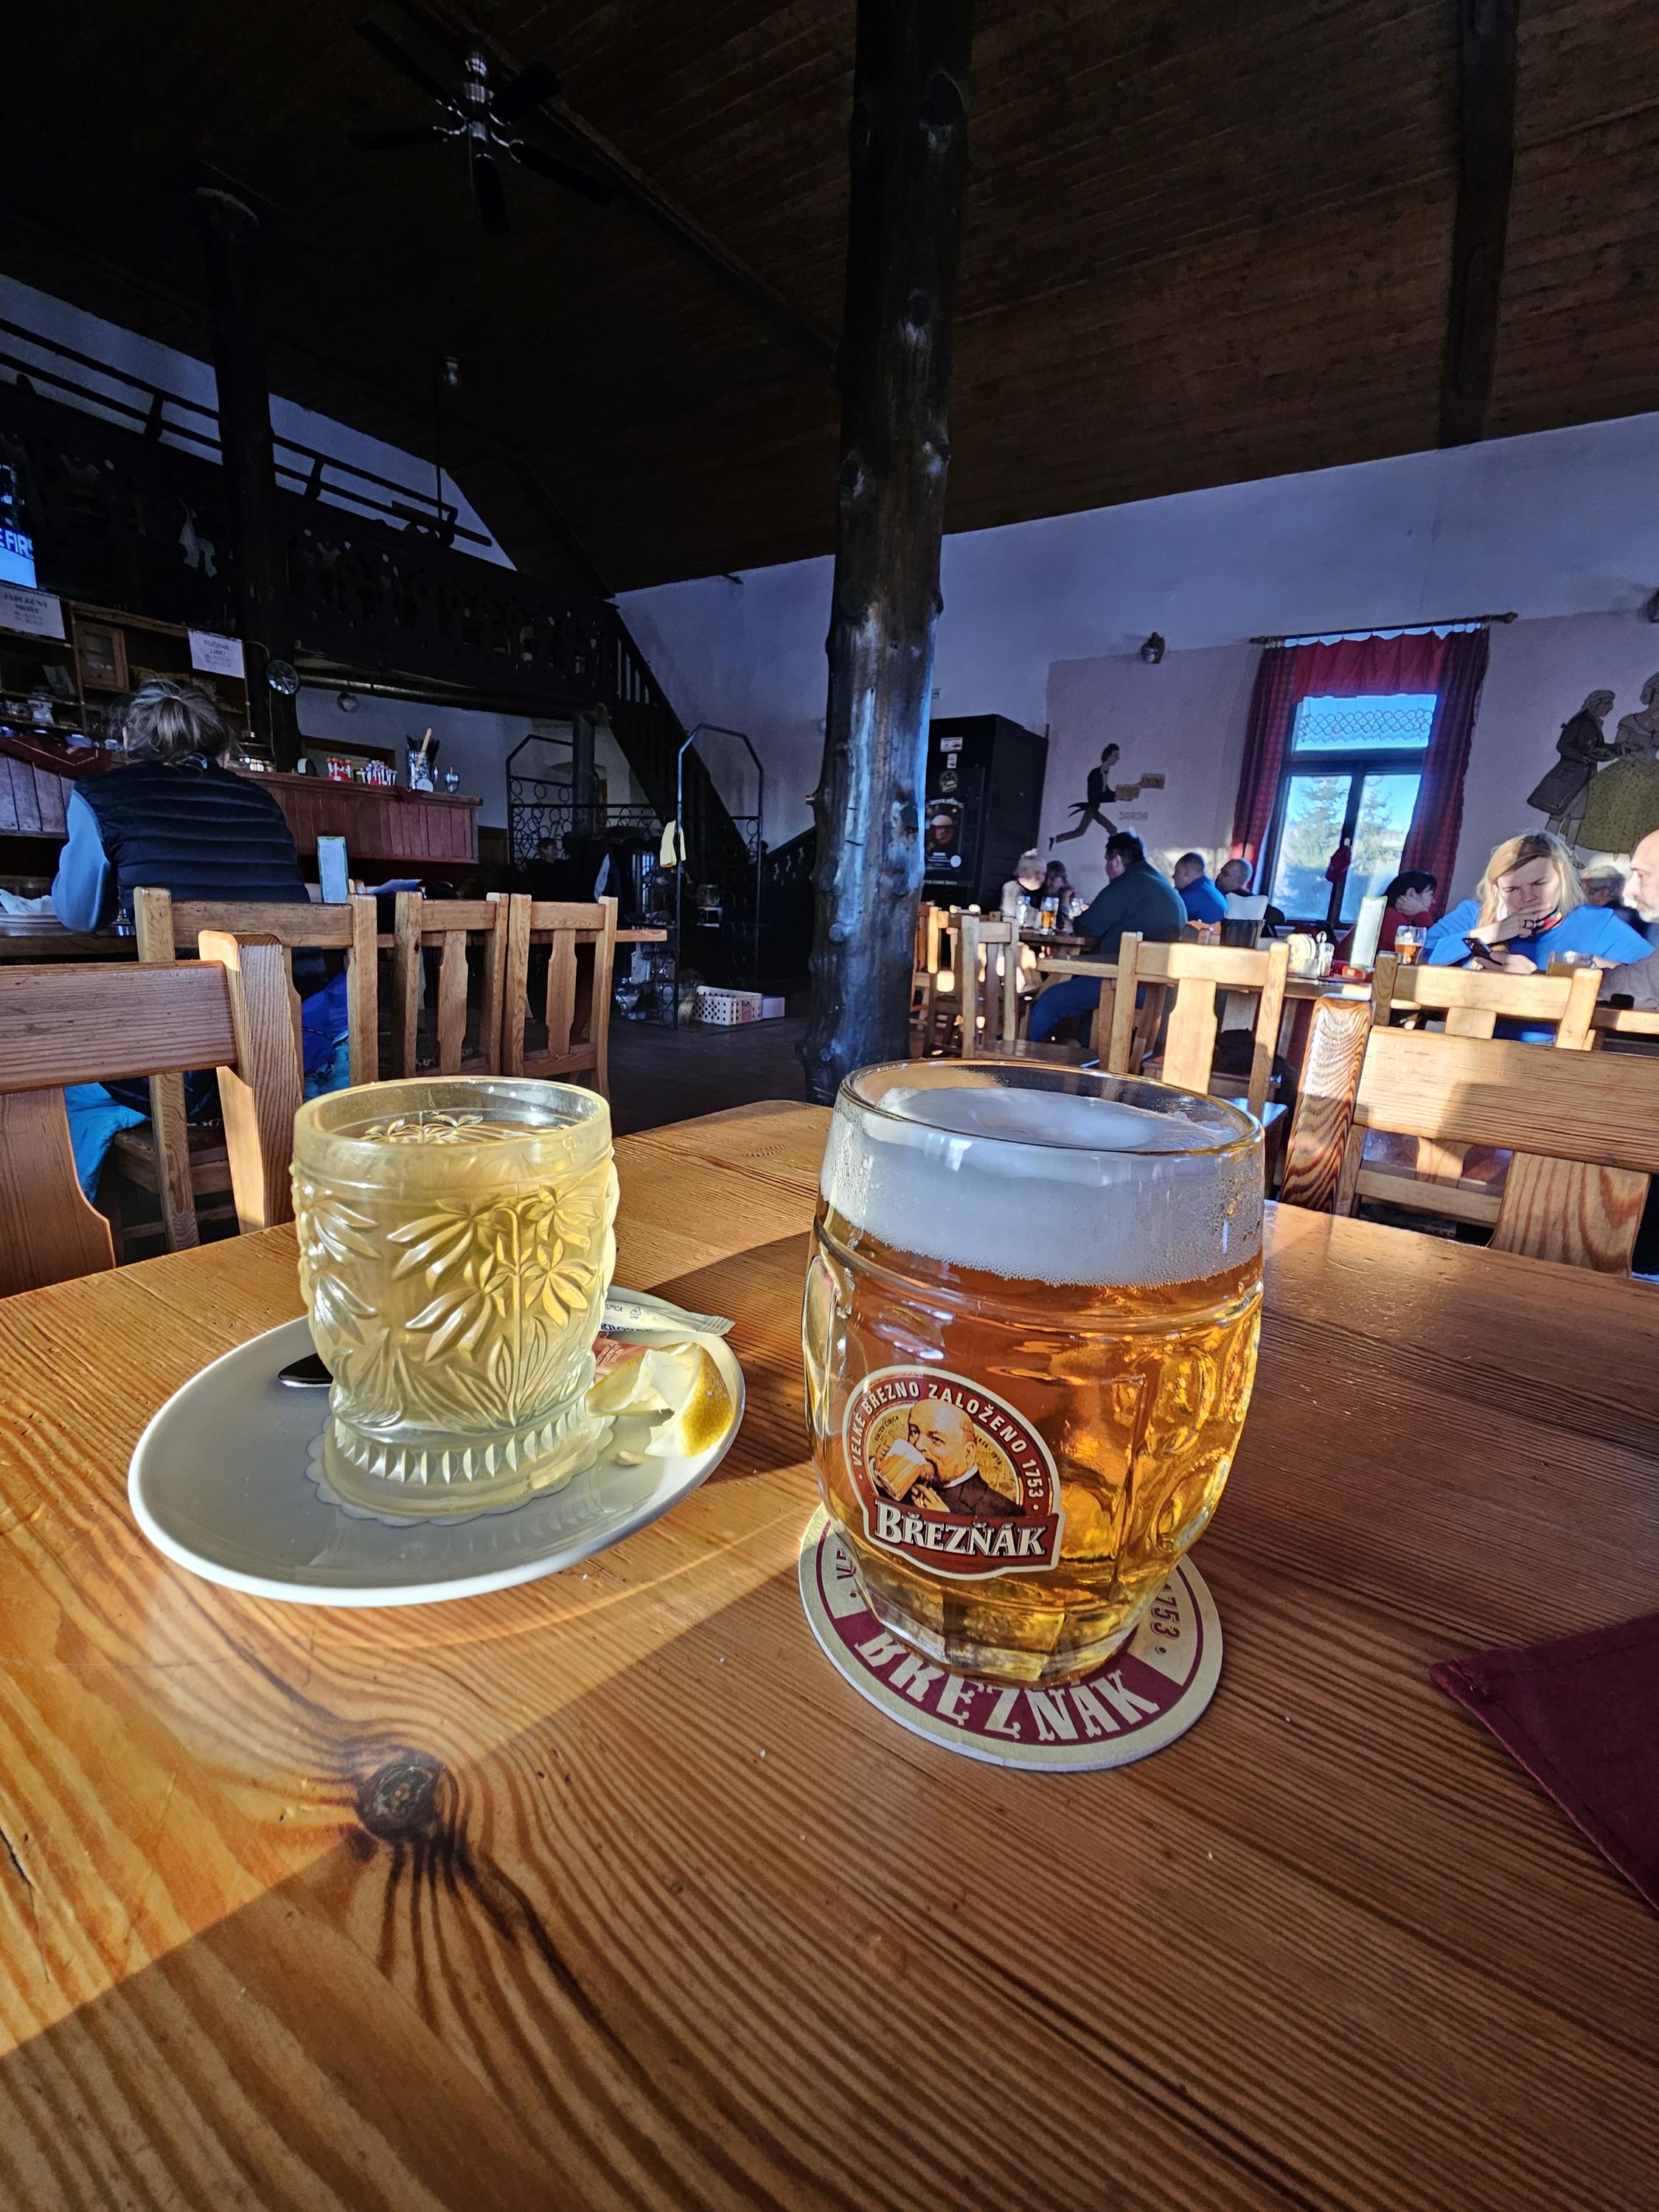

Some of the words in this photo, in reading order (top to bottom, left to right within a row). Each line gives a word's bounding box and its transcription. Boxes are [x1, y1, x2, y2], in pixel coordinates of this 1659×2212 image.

[852, 1411, 866, 1467] VELKÉ
[861, 1381, 919, 1415] BŘEZNO
[928, 1383, 1027, 1454] ZALOŽENO
[1022, 1459, 1044, 1498] 1753
[874, 1499, 1046, 1557] BŘEZŇÁK
